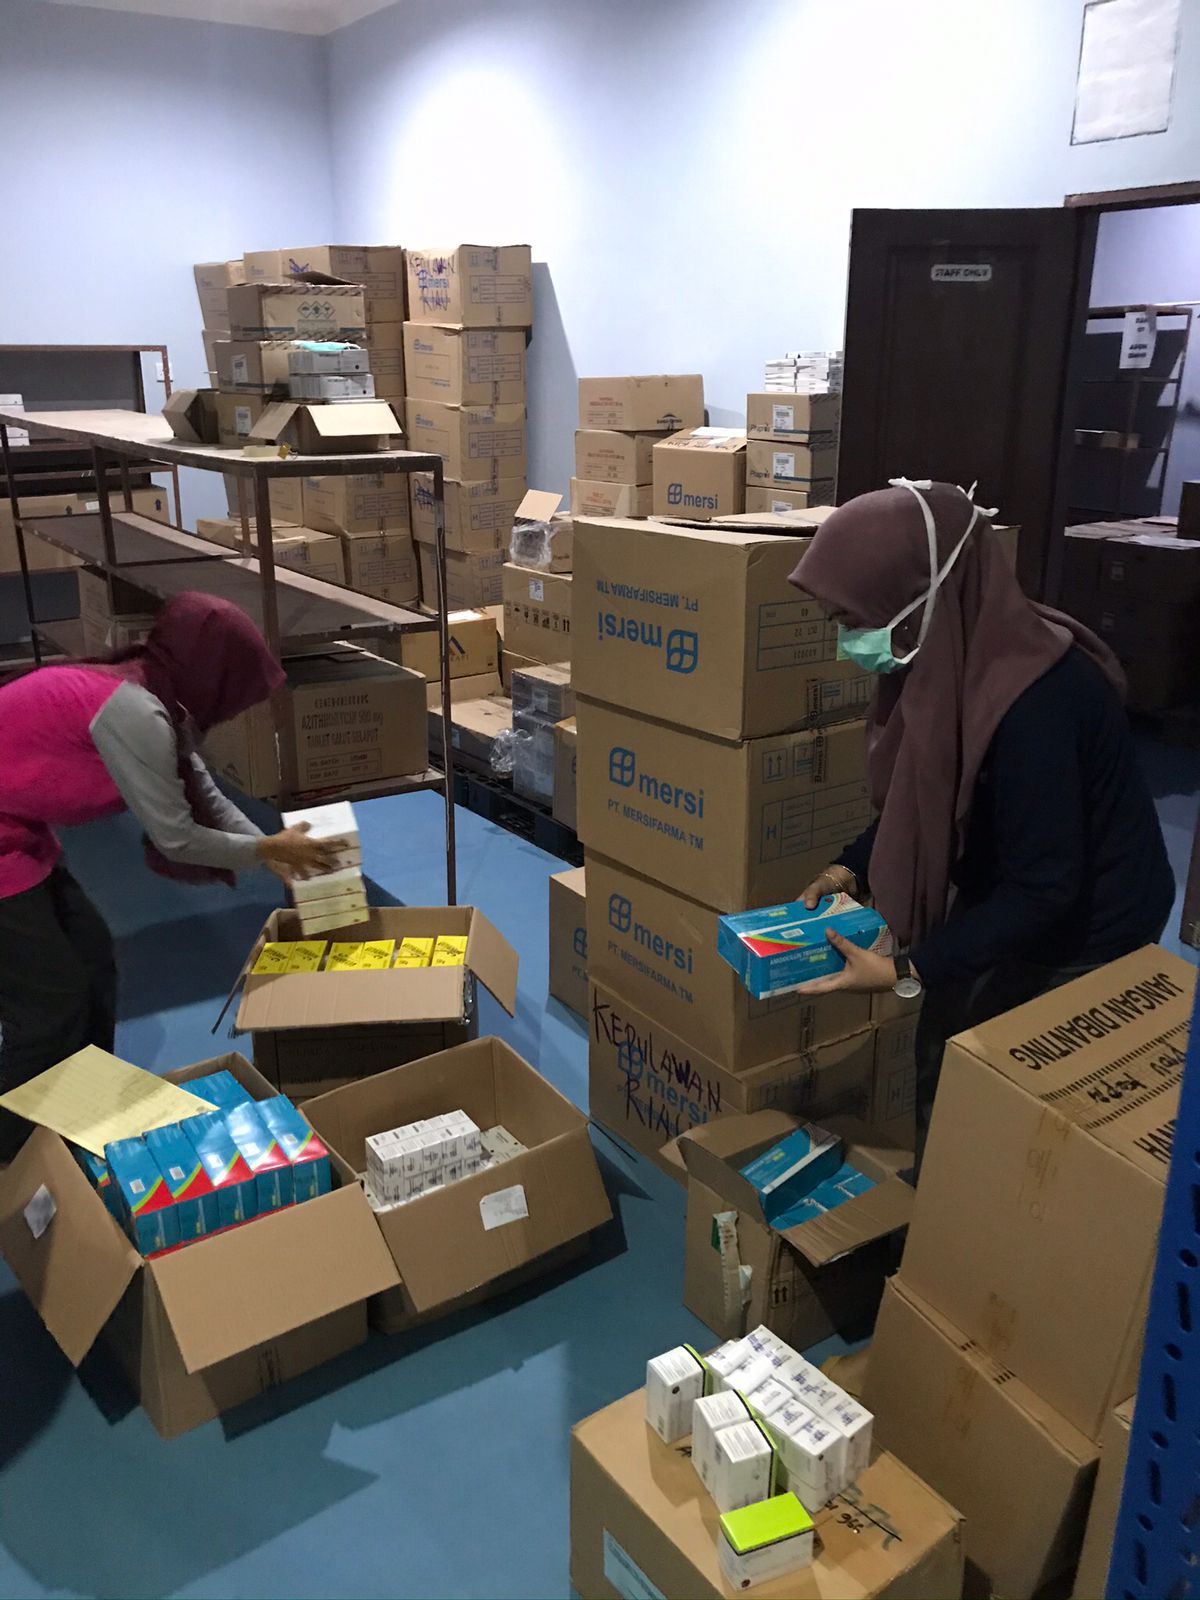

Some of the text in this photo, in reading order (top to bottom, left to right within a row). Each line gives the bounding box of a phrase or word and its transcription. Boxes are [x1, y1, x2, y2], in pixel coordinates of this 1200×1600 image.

[683, 493, 719, 510] mersi
[610, 583, 680, 609] MERSIFARMA
[597, 612, 663, 649] mersi
[638, 770, 705, 818] mersi
[622, 802, 687, 842] MERSIFARMA
[633, 921, 693, 975] mersi
[620, 948, 678, 997] MERSIFARMA
[1102, 972, 1185, 1024] JANGAN
[1008, 1007, 1122, 1071] DIBANTING
[646, 1071, 708, 1124] mersi
